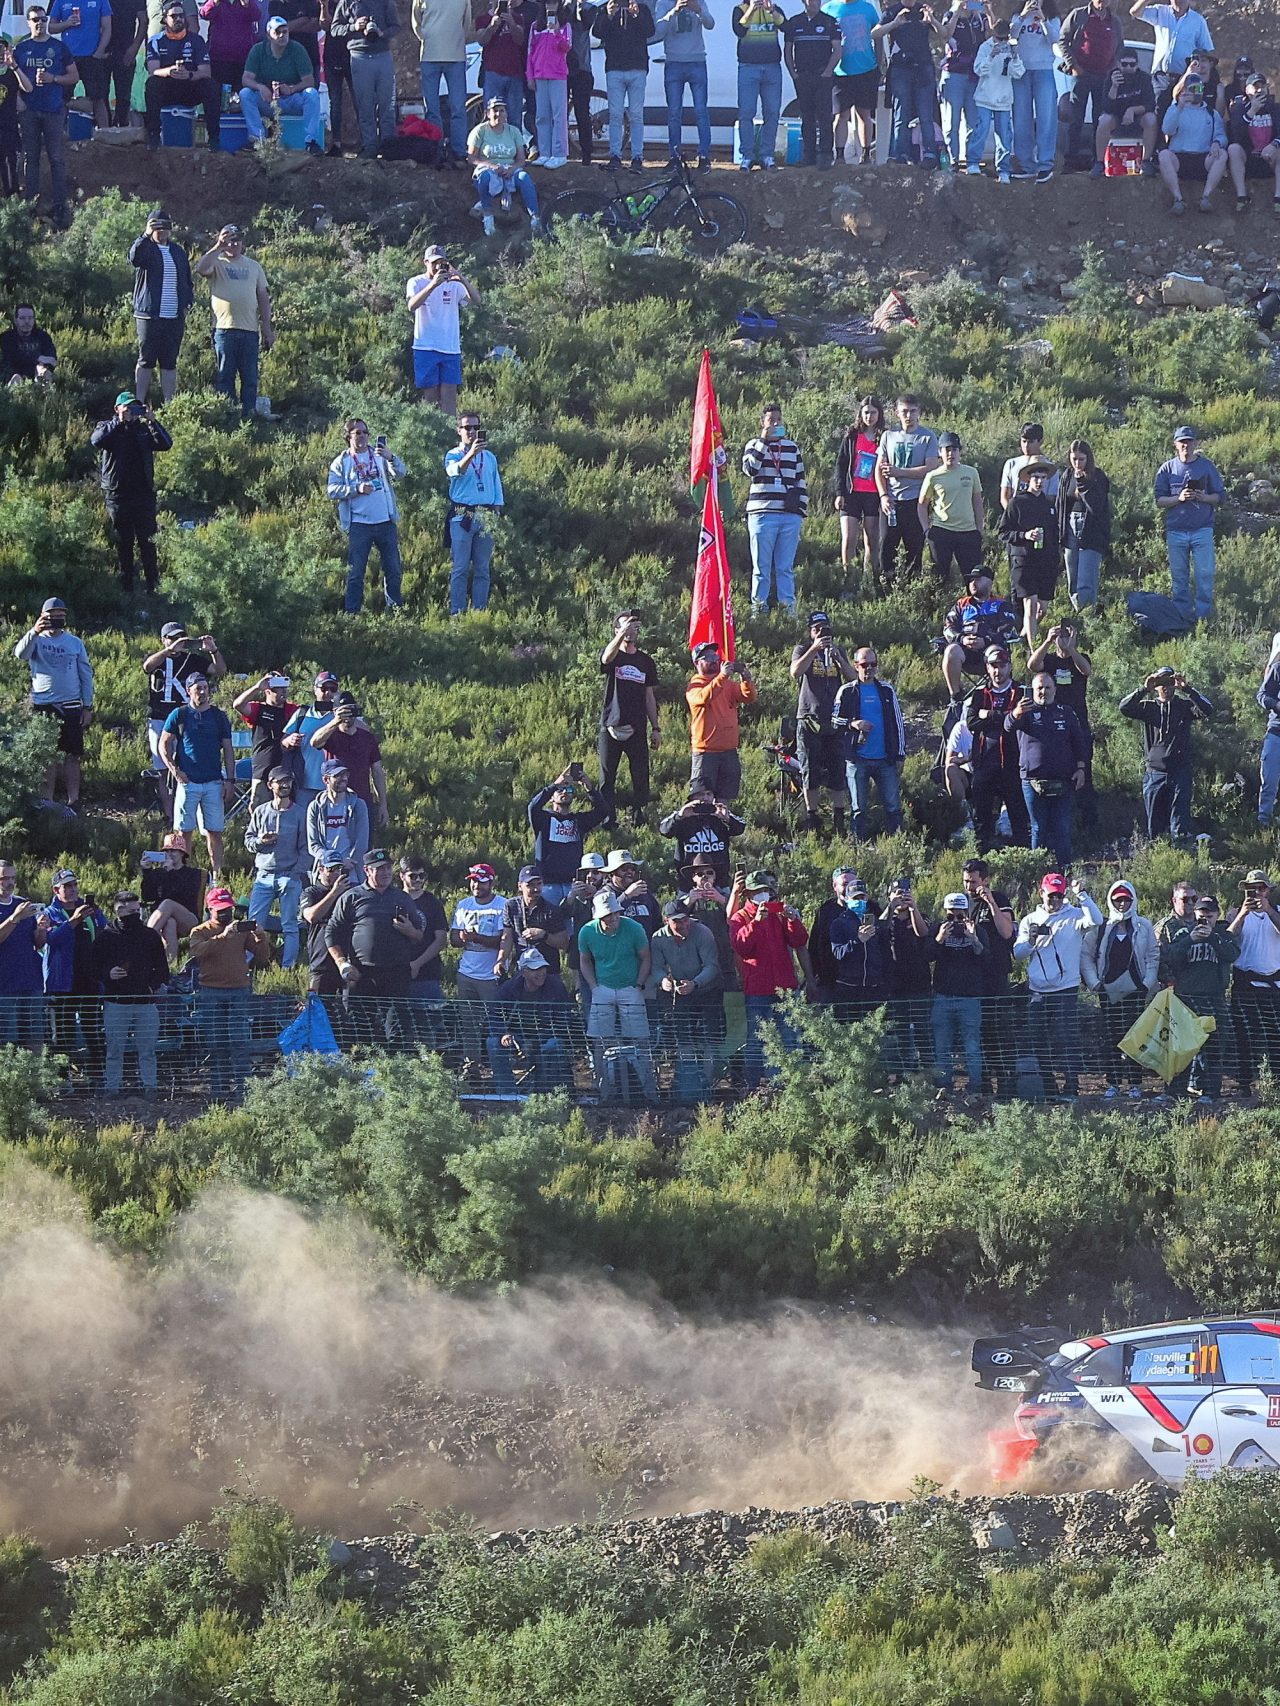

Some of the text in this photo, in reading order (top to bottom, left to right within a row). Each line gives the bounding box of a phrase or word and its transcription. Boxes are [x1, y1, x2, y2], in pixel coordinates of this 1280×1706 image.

[26, 58, 54, 67] MEO
[684, 841, 725, 853] adidas
[1199, 1344, 1217, 1374] 11
